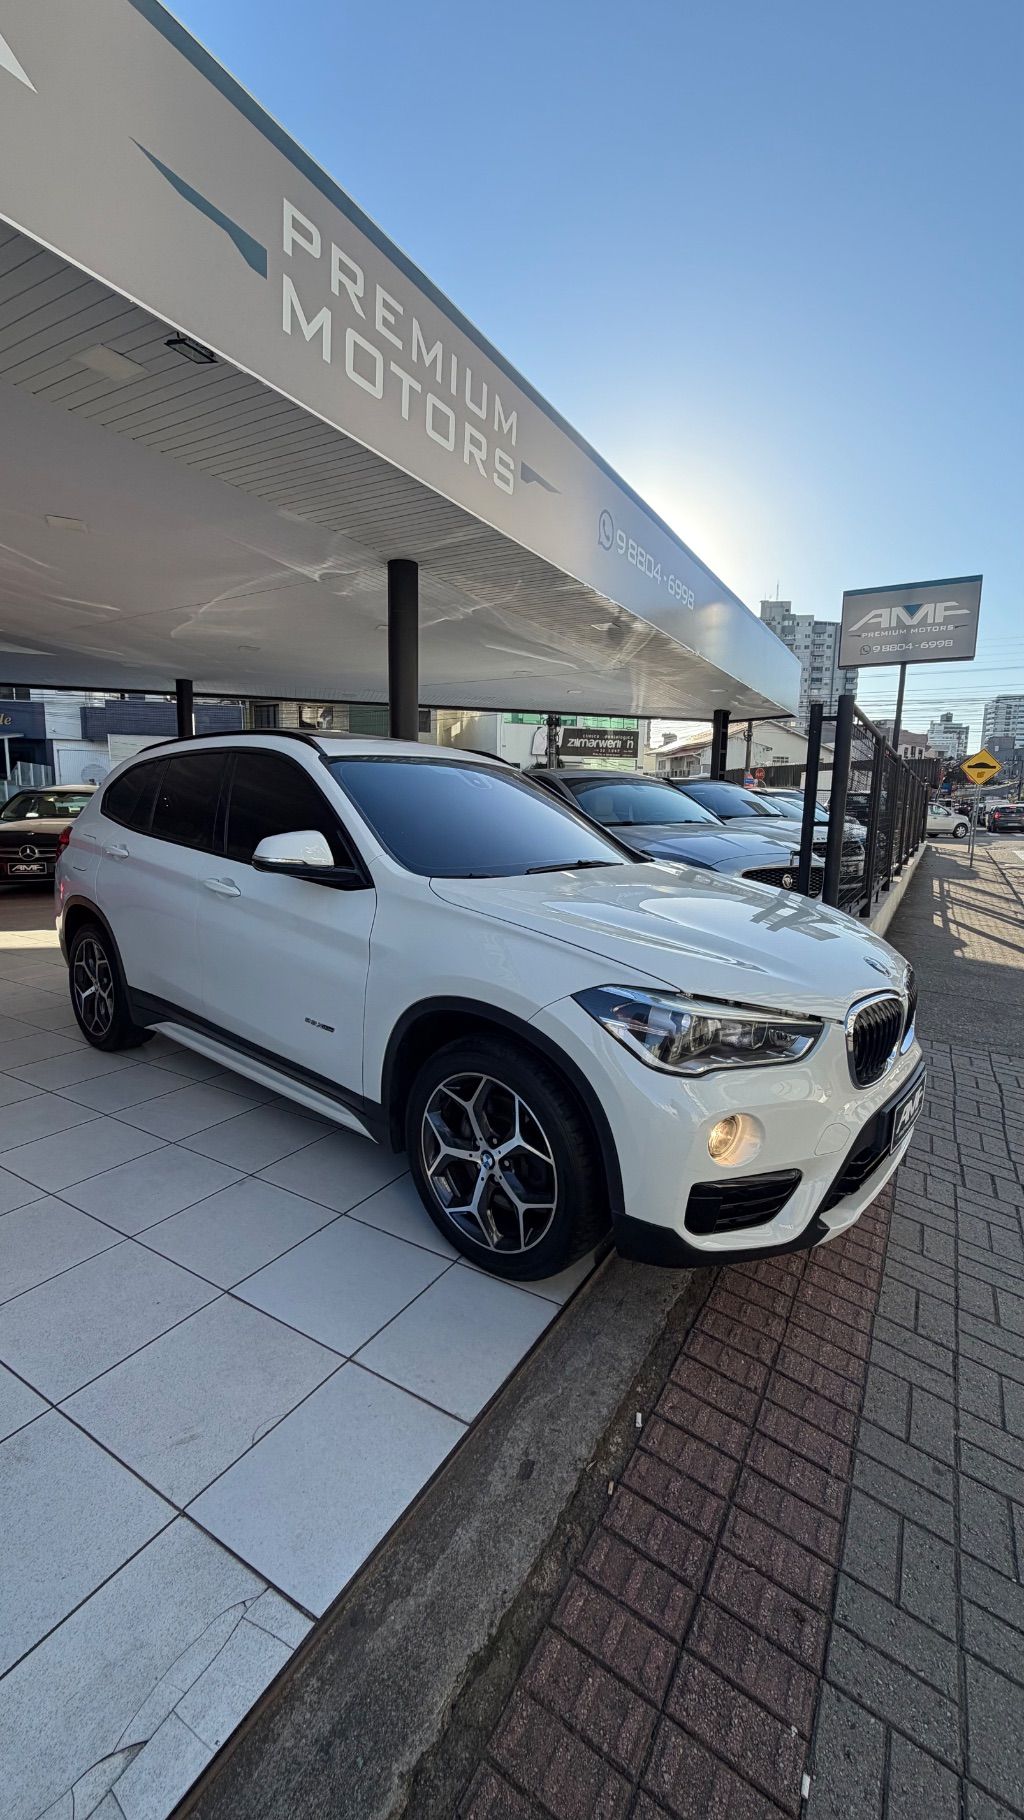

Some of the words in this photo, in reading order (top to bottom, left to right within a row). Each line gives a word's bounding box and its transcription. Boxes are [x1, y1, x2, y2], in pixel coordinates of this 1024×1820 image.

[283, 197, 518, 446] PREMIUM
[282, 273, 515, 496] MOTORS
[848, 601, 971, 632] AMF
[861, 629, 907, 639] PREMIUM
[911, 624, 954, 634] MOTORS
[11, 864, 44, 872] AMF
